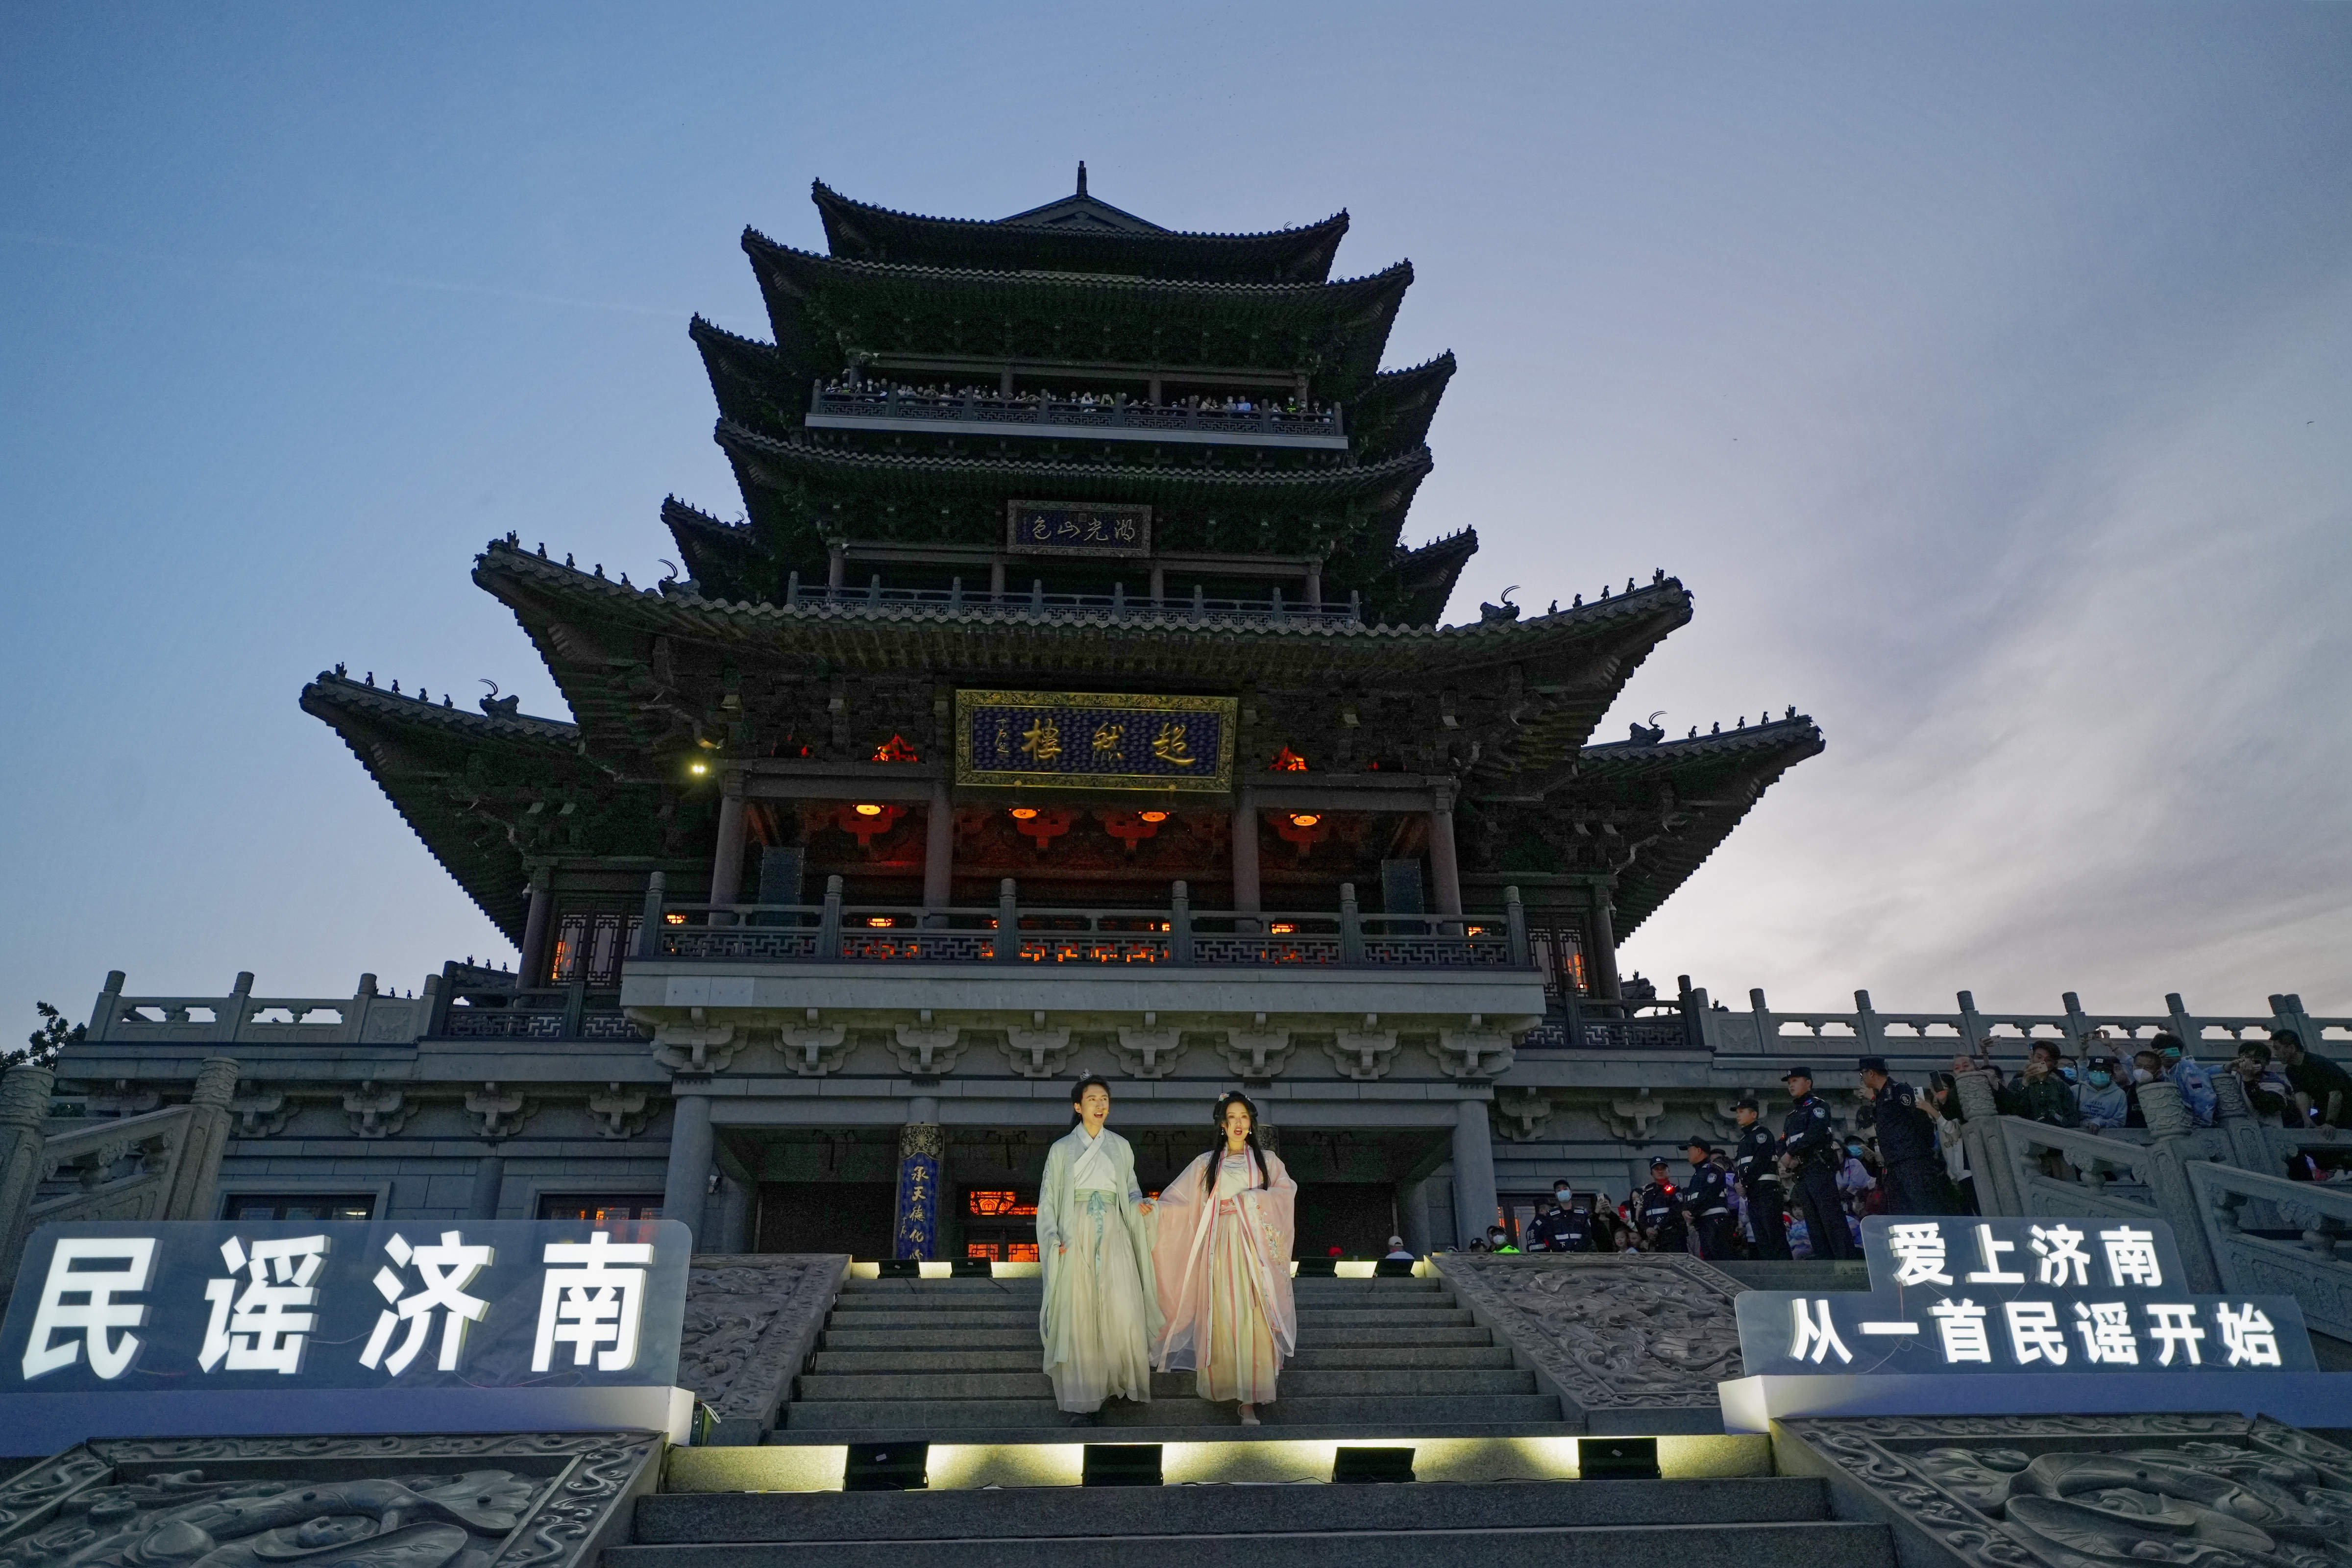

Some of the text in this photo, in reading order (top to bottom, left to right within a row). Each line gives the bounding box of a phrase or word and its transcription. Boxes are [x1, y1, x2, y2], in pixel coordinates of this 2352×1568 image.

[1888, 1222, 2162, 1288] 爱上济南
[22, 1230, 654, 1380] 民谣济南
[1788, 1297, 2282, 1368] 从一首民谣开始
